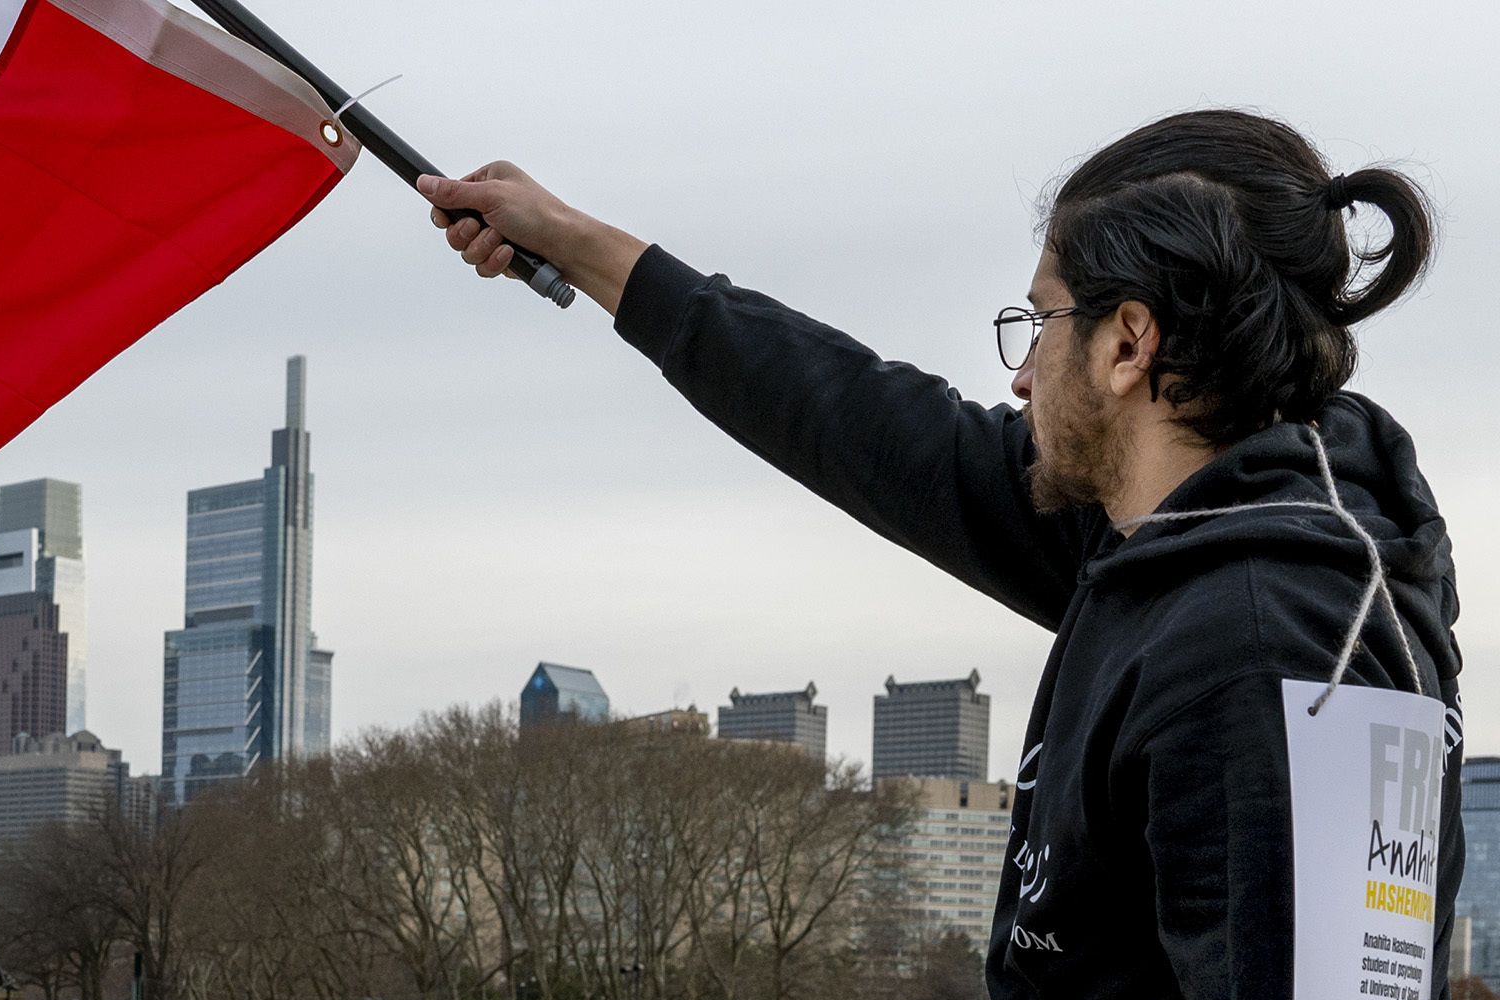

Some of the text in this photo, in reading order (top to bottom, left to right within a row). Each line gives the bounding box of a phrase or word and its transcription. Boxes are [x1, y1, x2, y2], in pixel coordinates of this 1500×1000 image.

[1363, 932, 1391, 951] Anahita
[1362, 956, 1389, 974] student
[1390, 961, 1397, 976] of
[1360, 979, 1368, 994] at
[1369, 980, 1401, 1000] University
[1401, 986, 1407, 1000] of
